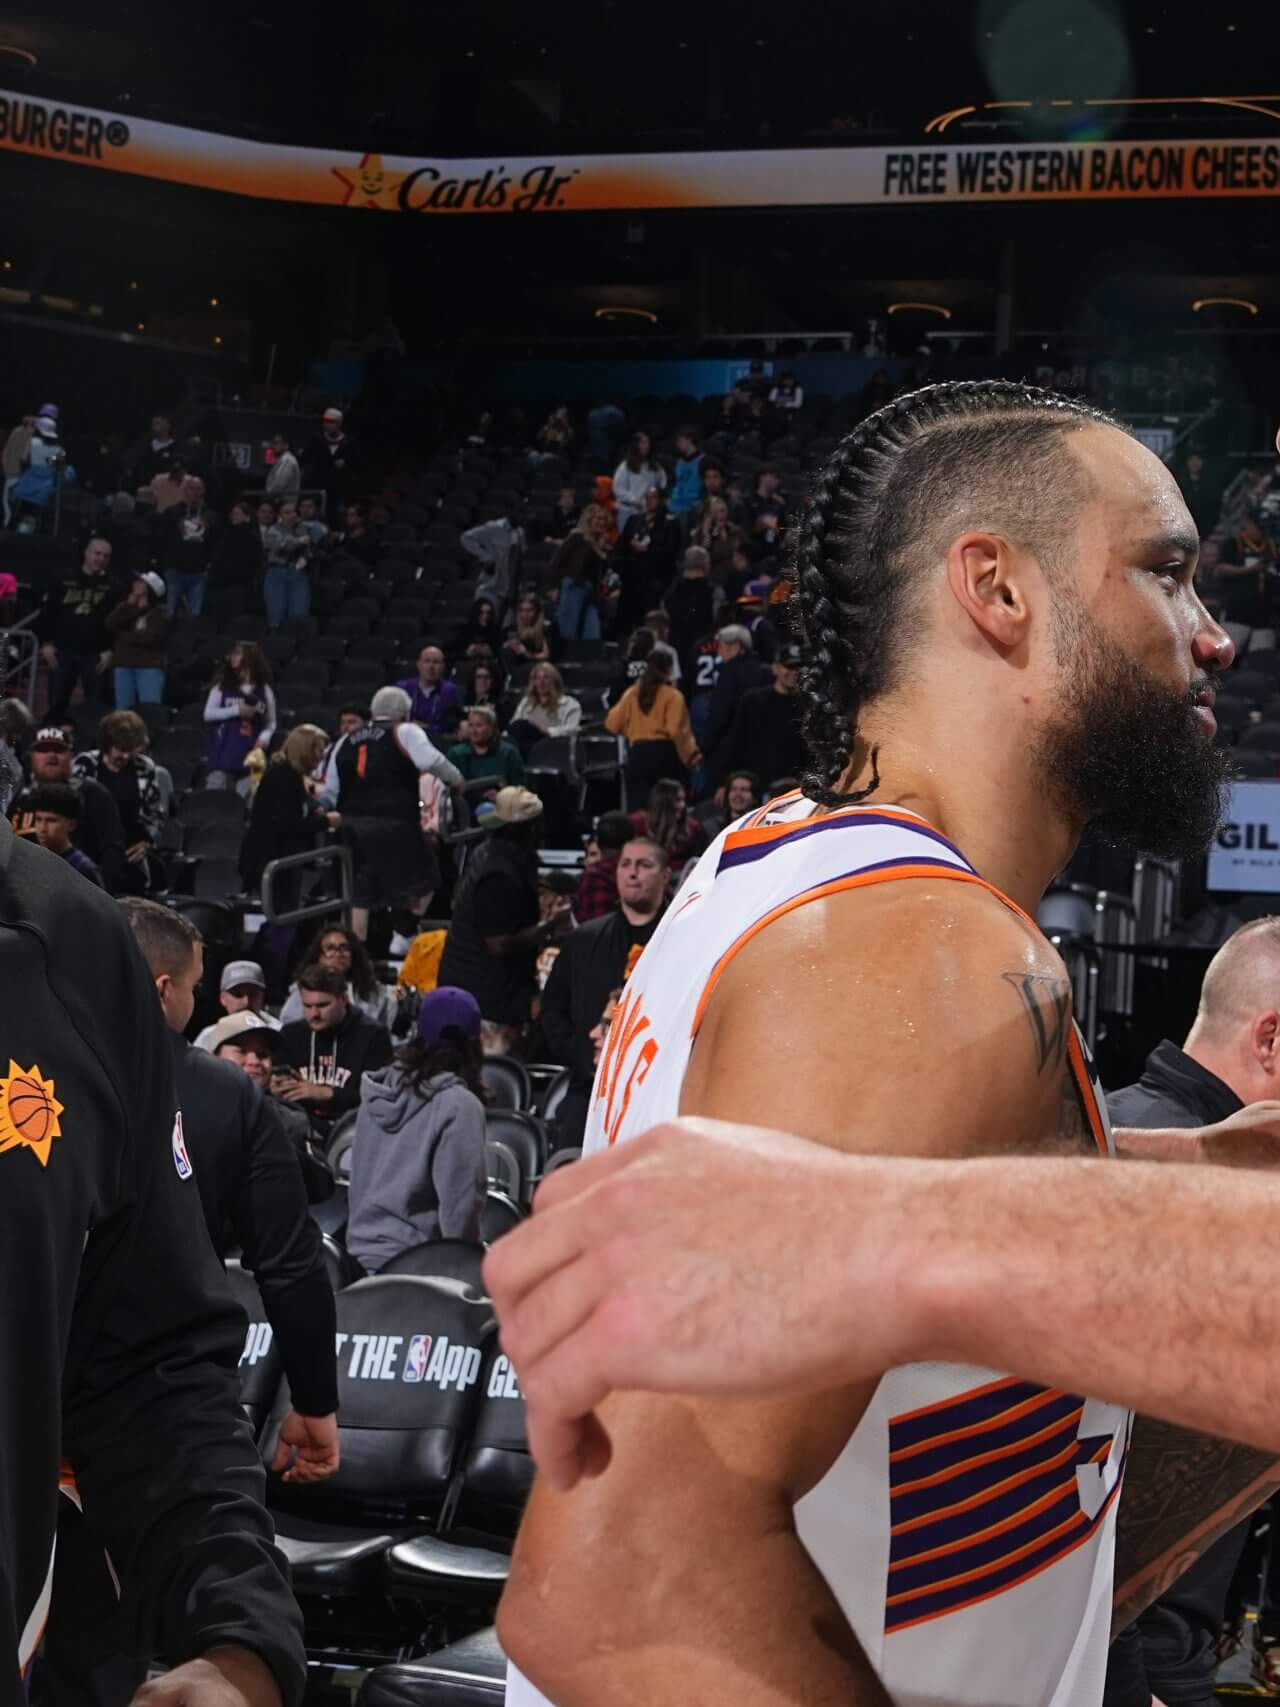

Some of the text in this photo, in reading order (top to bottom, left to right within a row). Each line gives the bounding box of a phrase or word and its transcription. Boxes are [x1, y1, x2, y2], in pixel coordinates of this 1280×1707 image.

[397, 165, 571, 215] Carl's Jr.
[884, 153, 948, 195] FREE
[957, 150, 1084, 194] WESTERN
[1090, 149, 1184, 191] BACON
[347, 1335, 403, 1380] THE
[424, 1336, 482, 1391] App
[487, 1354, 526, 1399] GE
